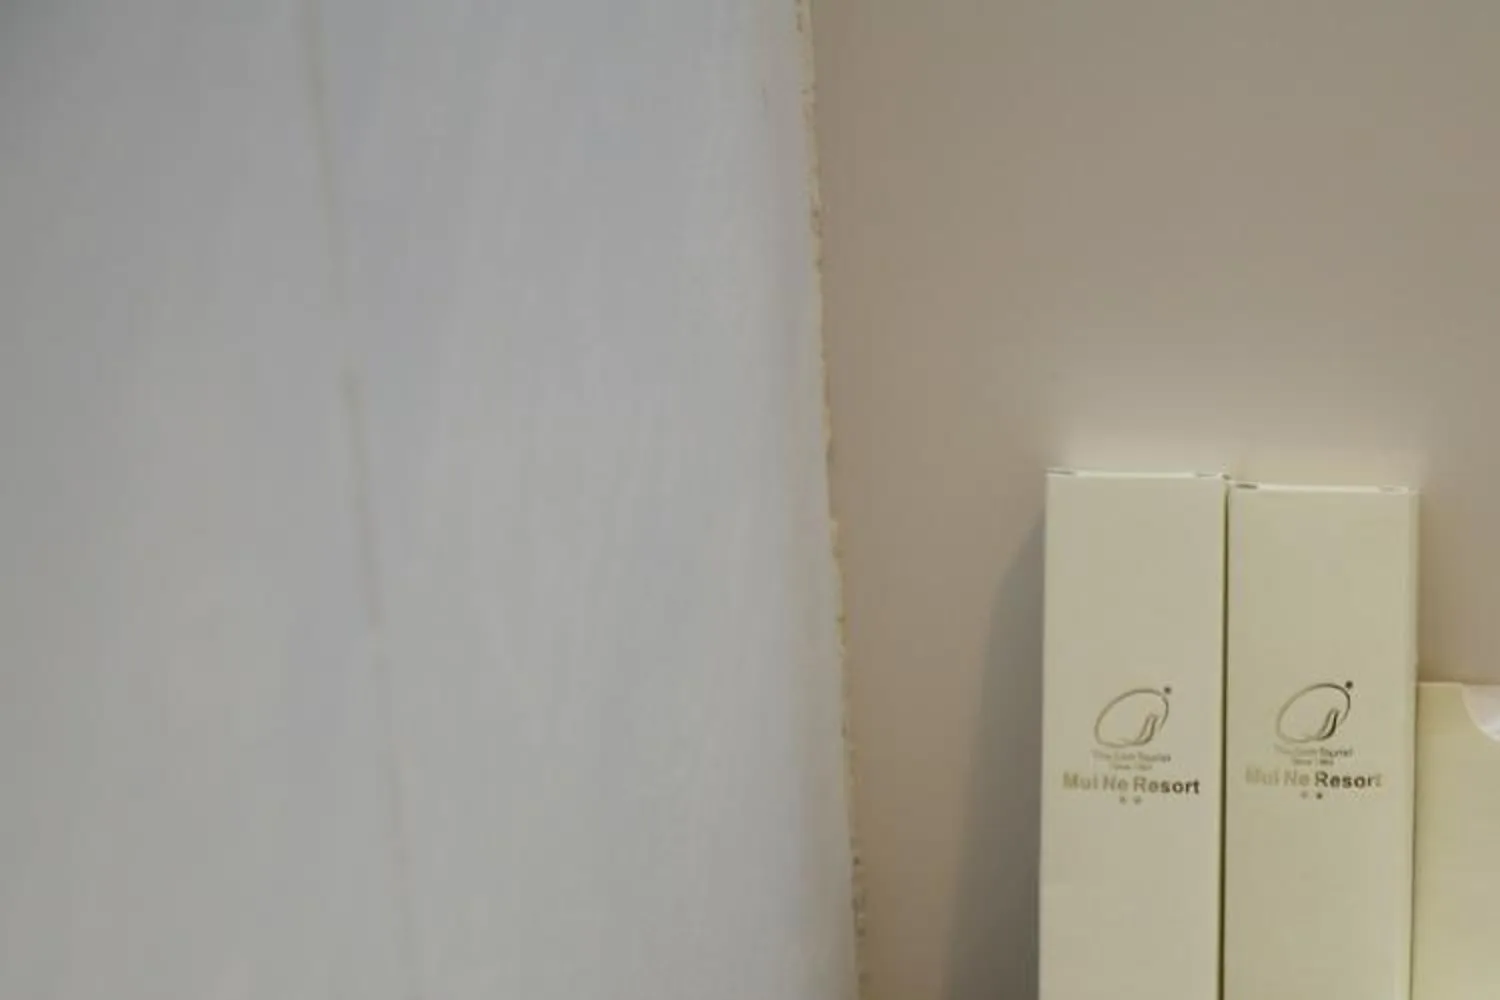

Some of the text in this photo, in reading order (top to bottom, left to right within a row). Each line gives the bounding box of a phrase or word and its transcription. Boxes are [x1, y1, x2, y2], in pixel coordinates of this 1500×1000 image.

[1062, 771, 1200, 795] Mui Ne Resort
[1284, 769, 1311, 787] Ne
[1314, 770, 1384, 788] Resort
